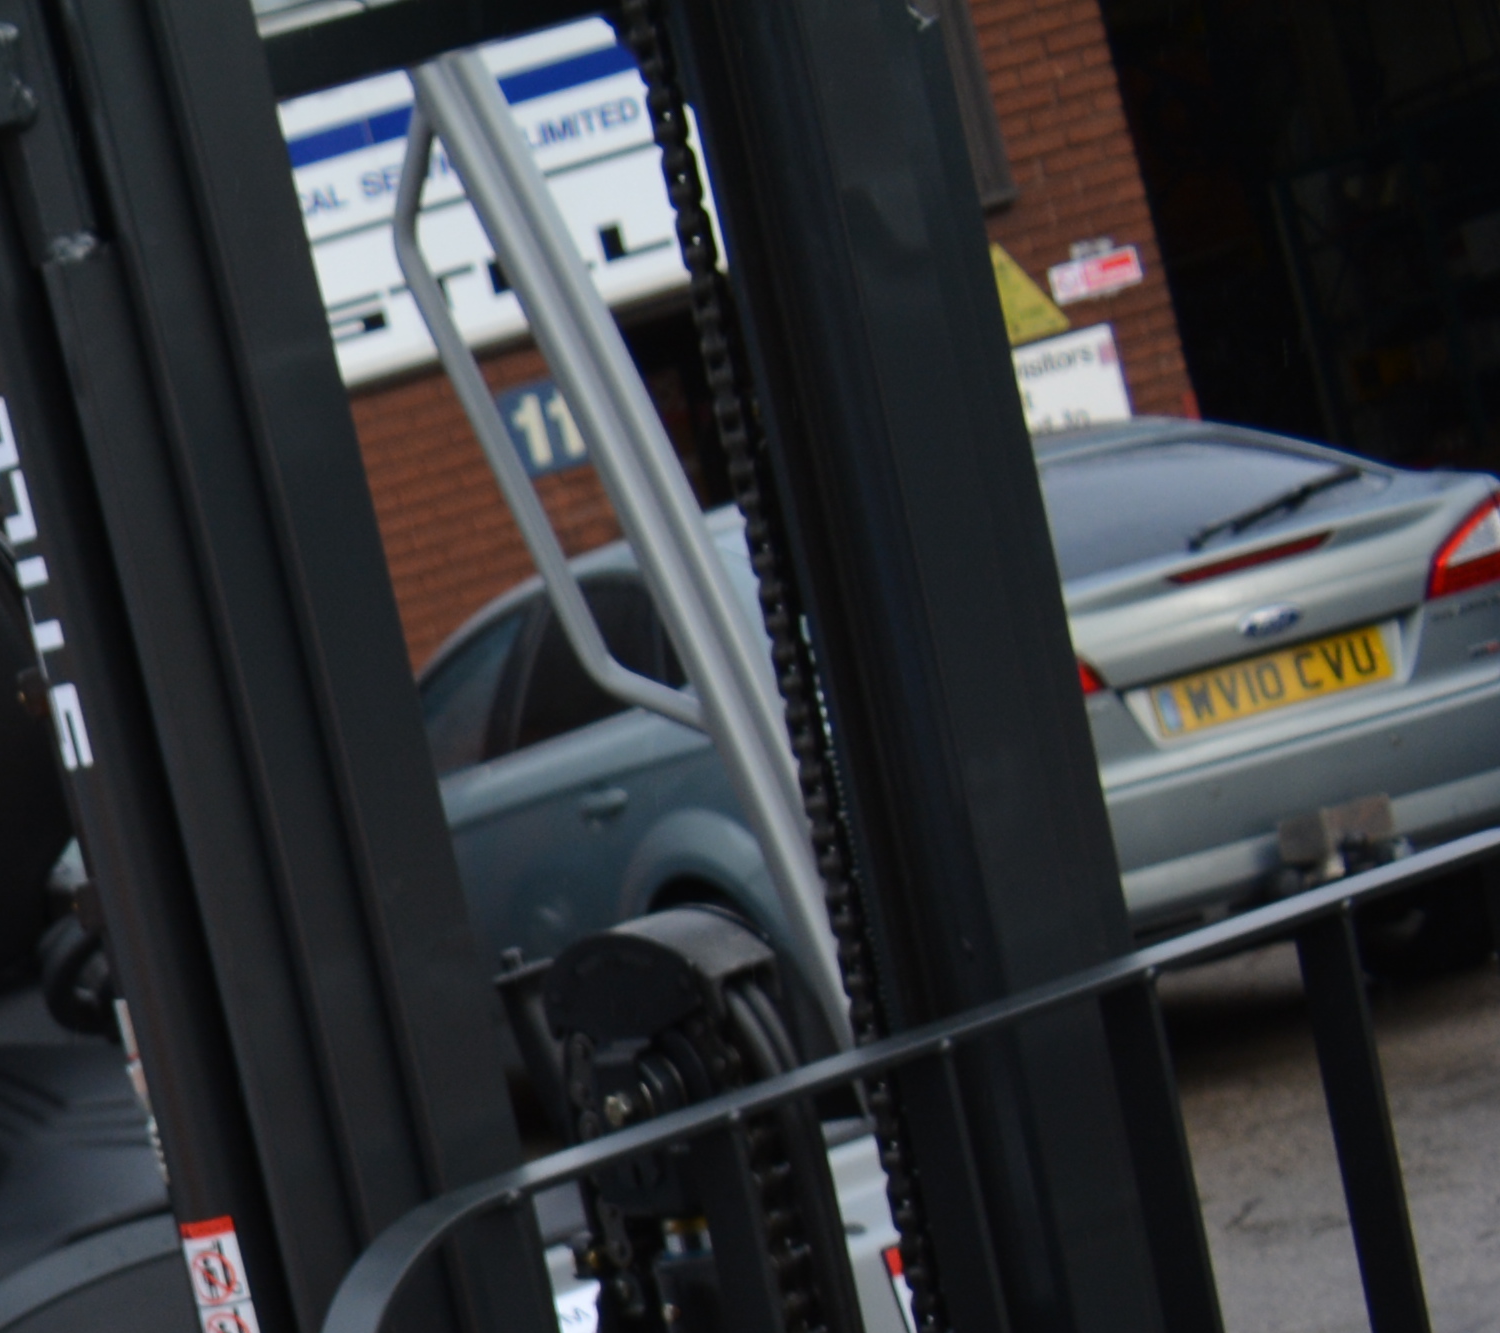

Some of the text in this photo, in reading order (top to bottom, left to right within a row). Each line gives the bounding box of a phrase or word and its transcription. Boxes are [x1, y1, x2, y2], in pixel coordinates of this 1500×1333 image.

[300, 98, 639, 214] AL LIMITED
[1292, 635, 1376, 691] CVU
